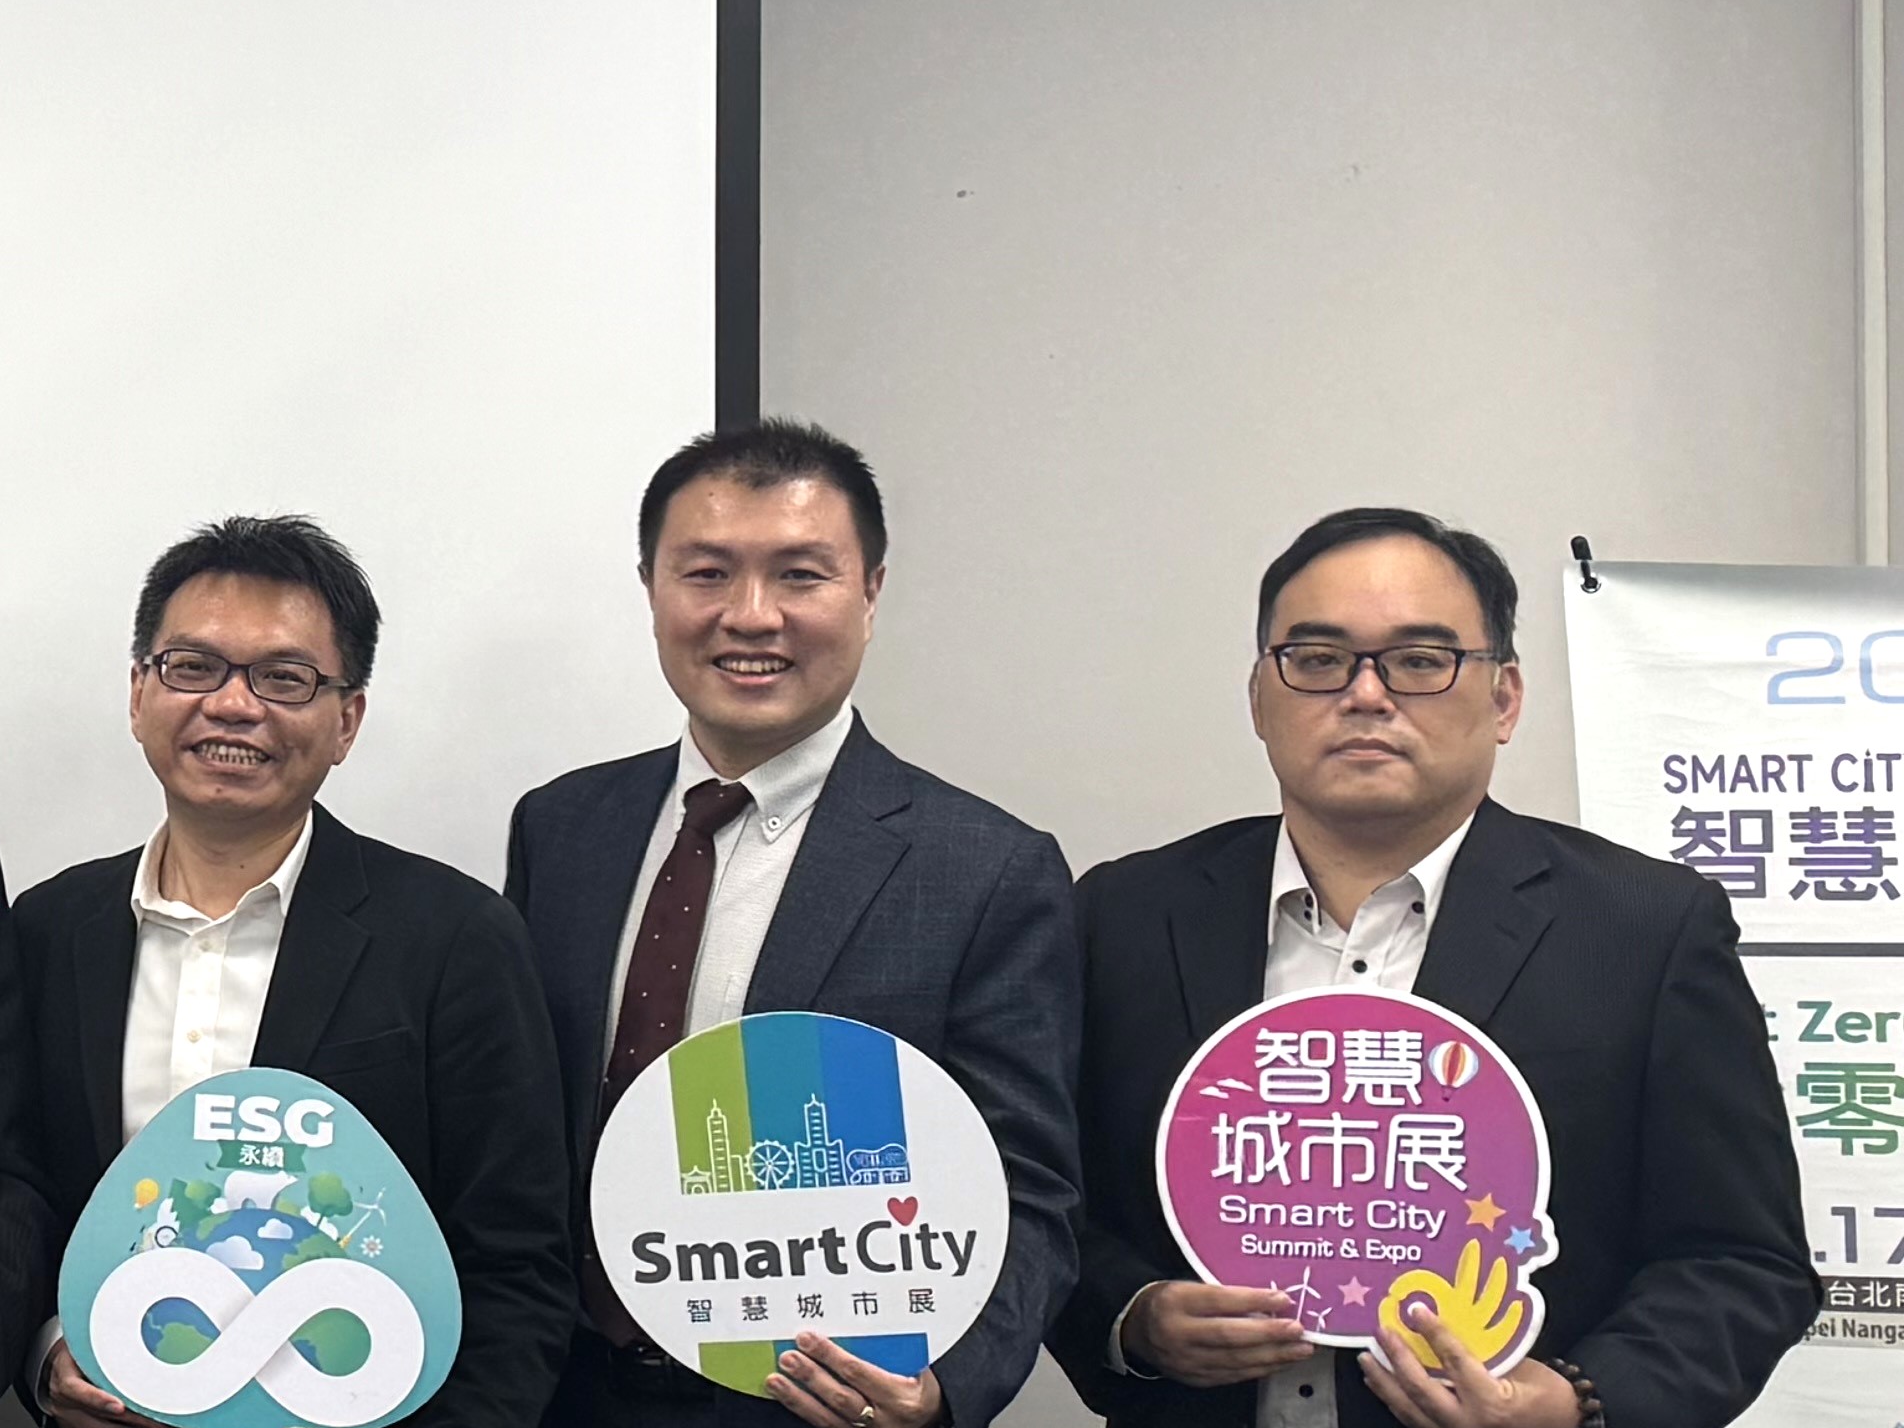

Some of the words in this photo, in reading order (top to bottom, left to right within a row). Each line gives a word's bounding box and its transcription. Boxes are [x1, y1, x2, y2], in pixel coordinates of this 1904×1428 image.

[1663, 754, 1813, 793] SMART
[1670, 805, 1900, 901] 智慧
[1797, 1001, 1904, 1044] Zer
[1254, 1028, 1423, 1106] 智慧
[193, 1093, 335, 1148] ESG
[1795, 1062, 1904, 1156] 零
[238, 1145, 285, 1168] 永續
[1211, 1110, 1468, 1191] 城市展
[1219, 1194, 1354, 1228] Smart
[1366, 1200, 1446, 1239] City
[1241, 1234, 1333, 1258] Summit
[1340, 1238, 1359, 1258] &
[1366, 1239, 1421, 1264] Expo
[687, 1288, 935, 1323] 智慧城市展
